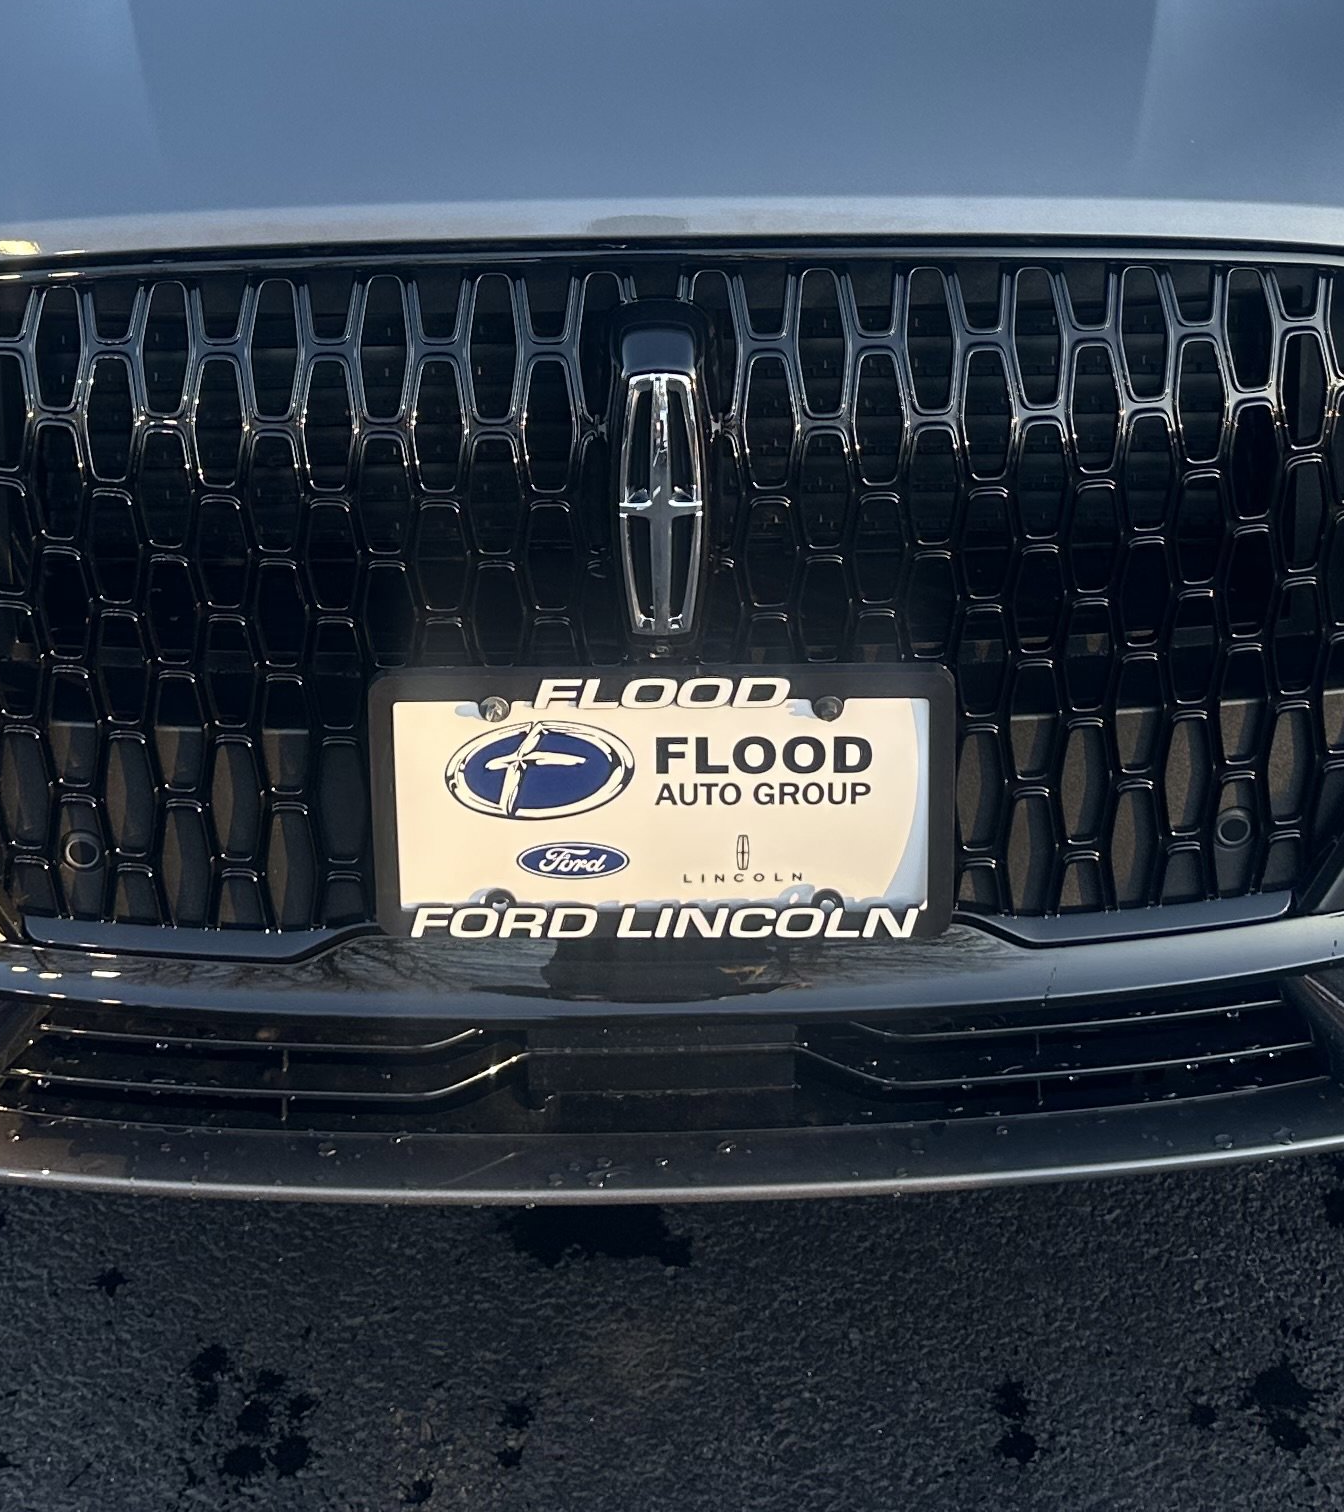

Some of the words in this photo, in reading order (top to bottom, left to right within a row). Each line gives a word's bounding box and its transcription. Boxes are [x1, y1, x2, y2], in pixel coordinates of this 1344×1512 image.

[533, 678, 791, 710] FLOOD
[654, 735, 873, 775] FLOOD
[654, 783, 743, 807] AUTO
[752, 782, 872, 806] GROUP
[537, 845, 607, 875] Ford
[683, 872, 804, 883] LINCOLN
[410, 907, 599, 939] FORD
[616, 907, 924, 939] LINCOLN
